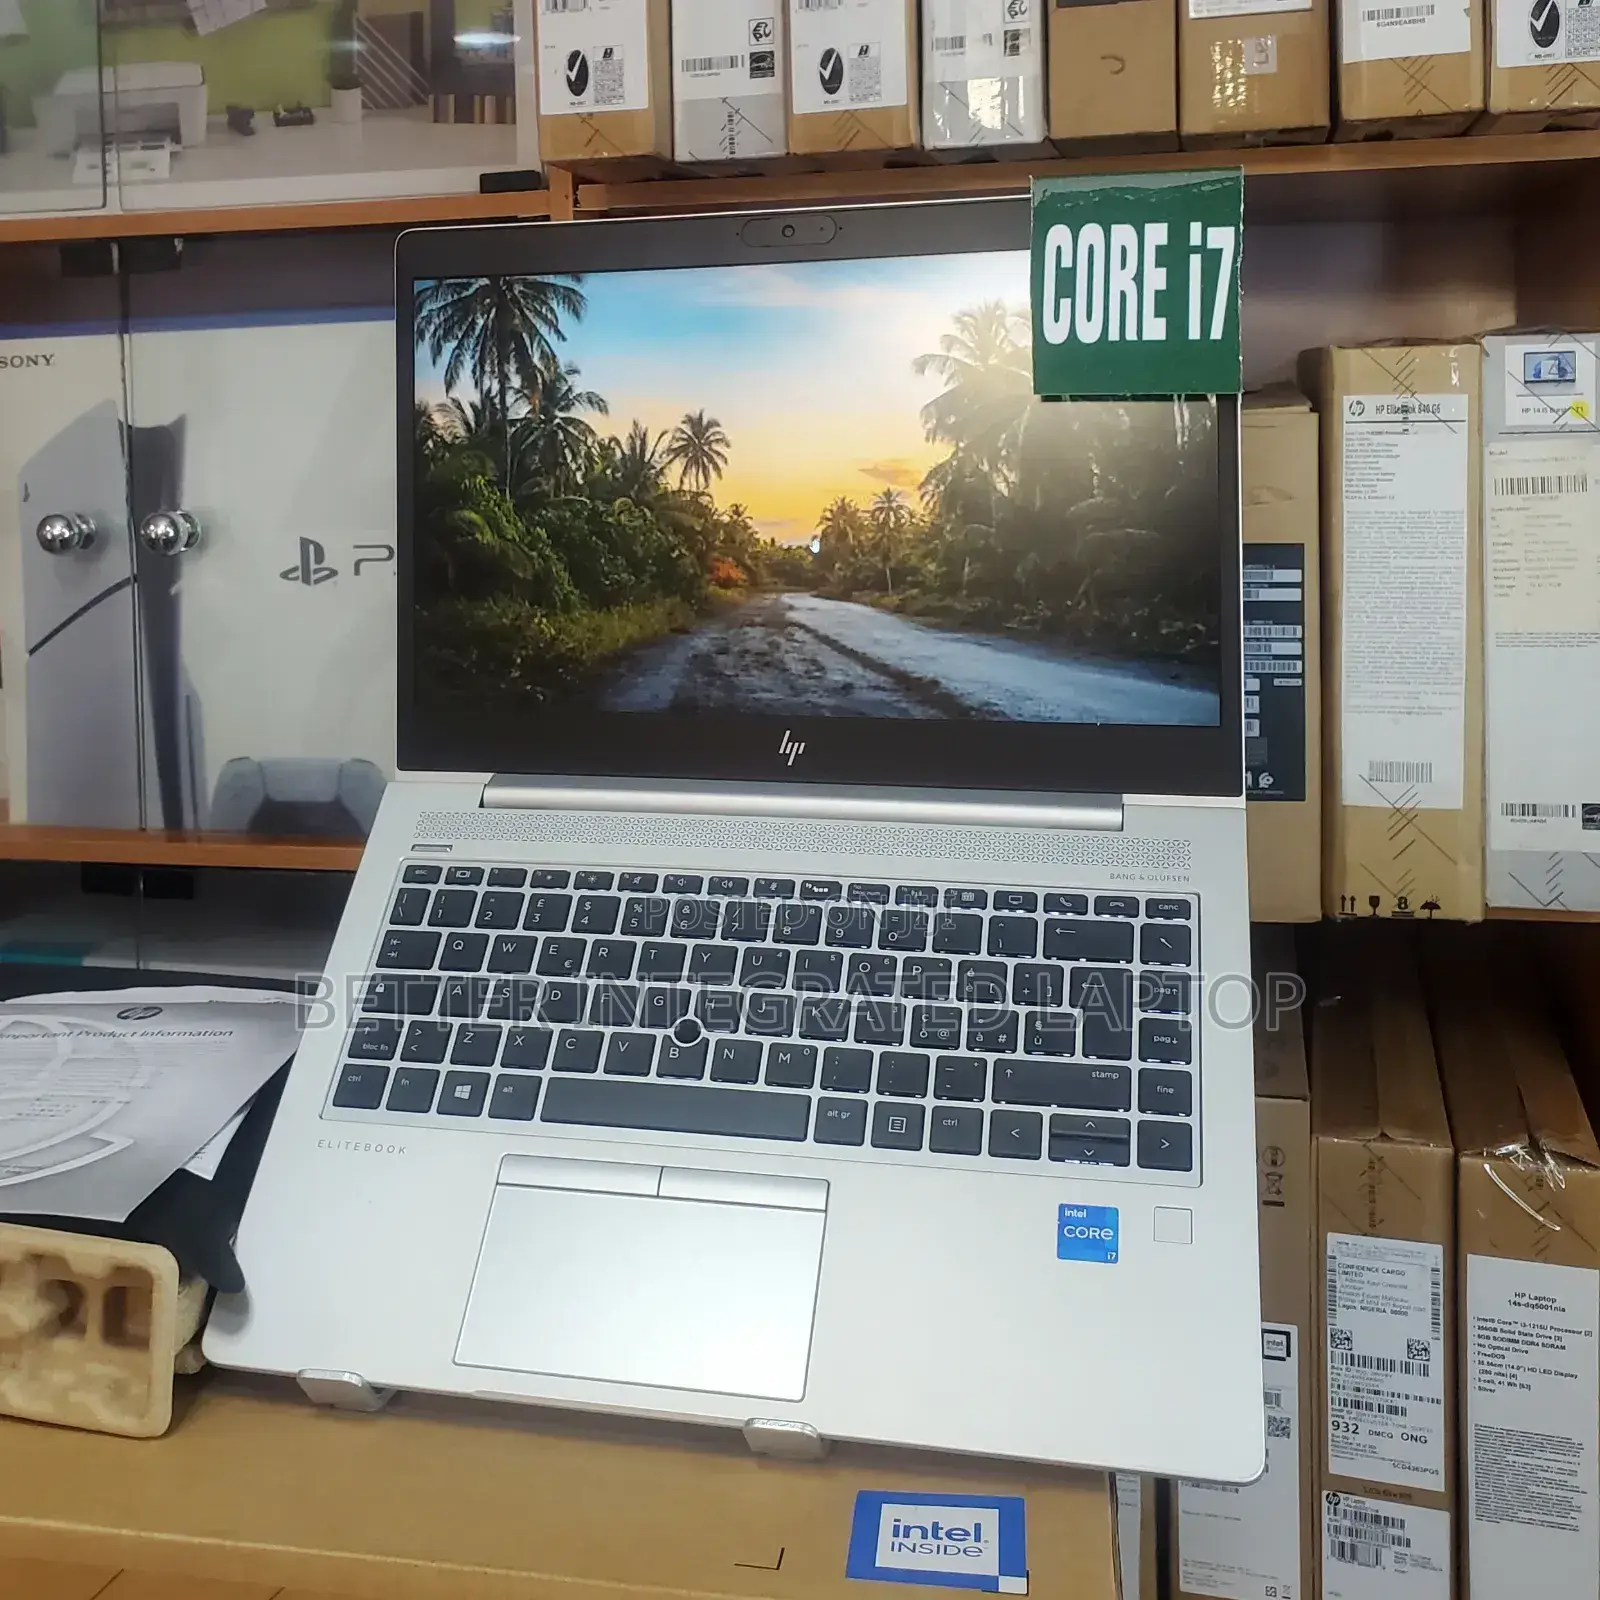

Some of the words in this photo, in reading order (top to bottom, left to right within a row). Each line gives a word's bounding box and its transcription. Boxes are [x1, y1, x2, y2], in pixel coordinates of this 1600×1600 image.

[1042, 222, 1168, 345] CORE
[1188, 221, 1235, 340] i7
[0, 353, 55, 368] SONY
[1375, 405, 1385, 415] HP
[1386, 404, 1416, 415] Eliteok
[353, 544, 395, 576] P
[778, 729, 806, 766] hp
[1109, 872, 1136, 881] BANG
[1147, 874, 1190, 883] OLUFSEN
[584, 901, 592, 911] $
[634, 904, 642, 913] %
[682, 904, 690, 914] &
[484, 911, 493, 920] 2
[532, 914, 541, 923] 3
[580, 916, 589, 924] 4
[630, 918, 638, 927] 5
[680, 920, 688, 930] 6
[732, 923, 739, 932] 7
[783, 926, 791, 935] 8
[836, 928, 844, 938] 9
[452, 940, 464, 951] Q
[502, 942, 516, 952] W
[548, 944, 559, 955] E
[598, 947, 609, 957] R
[649, 950, 658, 960] T
[701, 953, 711, 963] Y
[752, 956, 762, 966] U
[564, 960, 573, 968] €
[859, 962, 870, 972] O
[912, 966, 922, 976] P
[452, 986, 462, 996] A
[502, 988, 511, 998] S
[550, 990, 562, 1000] D
[600, 992, 610, 1002] F
[654, 996, 664, 1006] G
[704, 998, 715, 1009] H
[757, 1002, 766, 1013] J
[812, 1006, 822, 1018] K
[867, 1012, 874, 1022] L
[76, 1029, 138, 1039] Product
[139, 1028, 234, 1038] Information
[463, 1032, 474, 1043] Z
[937, 1028, 950, 1040] @
[998, 1034, 1007, 1043] #
[514, 1036, 525, 1046] X
[566, 1038, 576, 1049] C
[1154, 1035, 1171, 1044] pag
[618, 1041, 629, 1052] V
[670, 1048, 680, 1058] B
[723, 1049, 735, 1060] N
[778, 1053, 791, 1064] M
[348, 1074, 362, 1082] ctrl
[1092, 1070, 1119, 1080] stamp
[402, 1078, 410, 1086] fn
[1156, 1085, 1174, 1094] fine
[828, 1109, 838, 1117] alt
[840, 1111, 850, 1119] gr
[942, 1118, 958, 1127] ctrl
[317, 1139, 408, 1156] ELITEBOOK
[1064, 1208, 1087, 1218] intel
[1107, 1252, 1117, 1260] i7
[1338, 1263, 1379, 1273] CONFIDENCE
[1381, 1268, 1406, 1277] CARGO
[1338, 1270, 1364, 1278] LIMITED
[1528, 1293, 1557, 1304] Laptop
[1507, 1299, 1566, 1313] 14s-dq5001nia
[1550, 1325, 1583, 1335] Processor
[1536, 1332, 1552, 1340] Drive
[1488, 1344, 1511, 1352] Optical
[1512, 1346, 1529, 1354] Drive
[1527, 1366, 1538, 1374] HD
[1538, 1368, 1553, 1376] LED
[1554, 1370, 1578, 1380] Display
[1331, 1420, 1360, 1435] 932
[1400, 1432, 1428, 1444] ONG
[892, 1518, 984, 1543] intel
